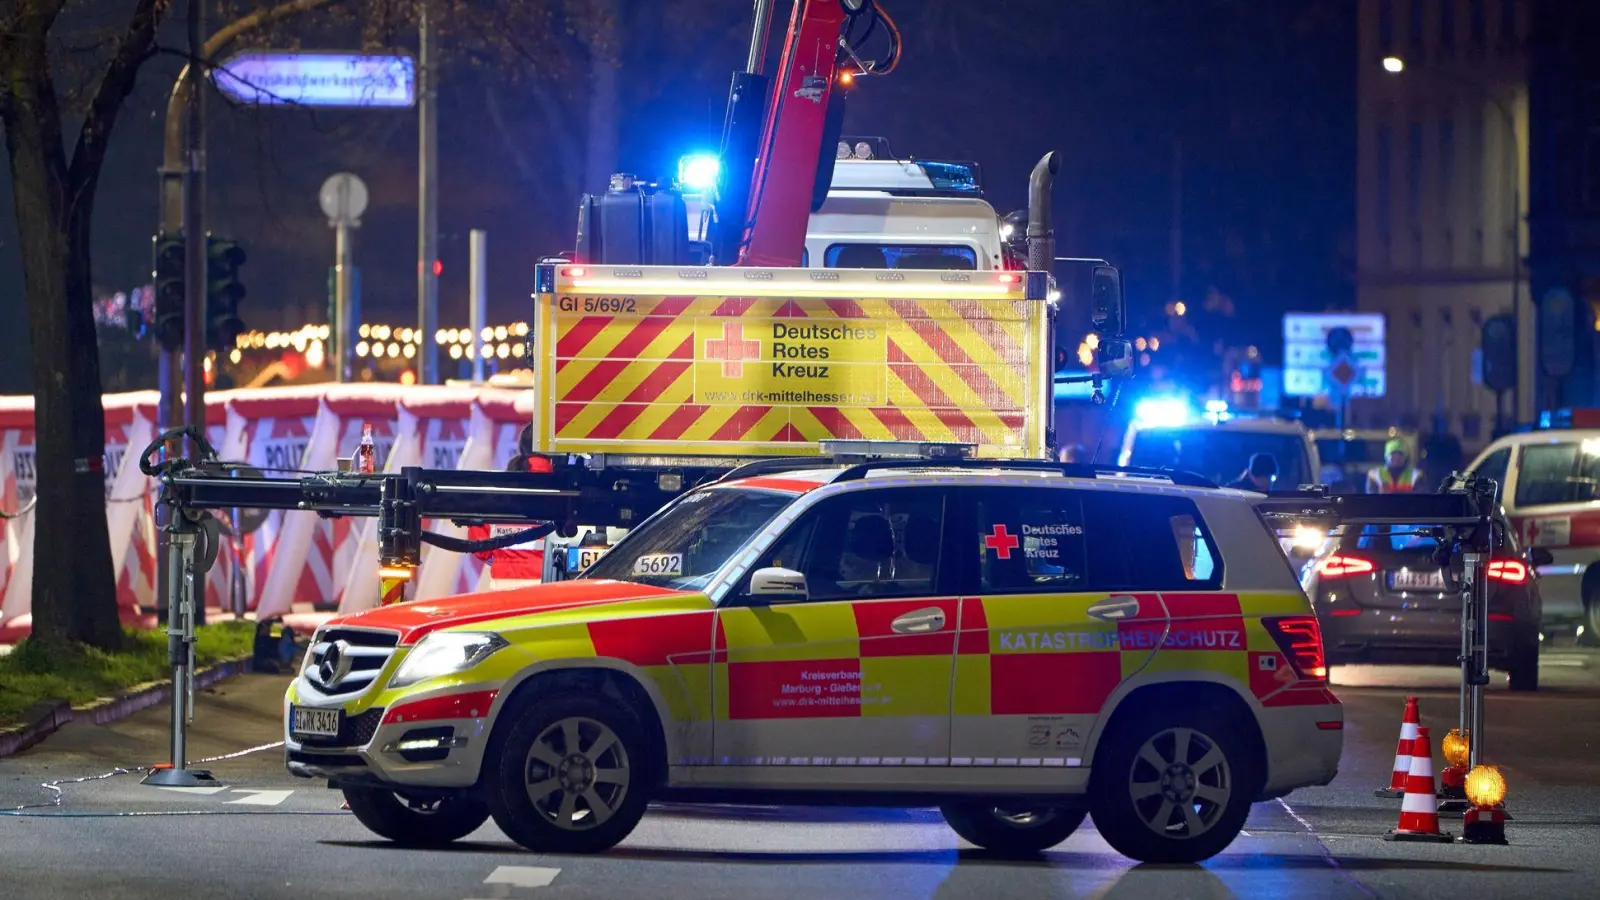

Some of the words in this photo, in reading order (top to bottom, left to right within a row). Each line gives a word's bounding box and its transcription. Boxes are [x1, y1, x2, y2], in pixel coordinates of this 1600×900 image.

[559, 296, 578, 311] GI
[584, 296, 636, 312] 5/69/2
[773, 323, 877, 340] Deutsches
[772, 342, 829, 359] Rotes
[772, 362, 829, 378] Kreuz
[1022, 524, 1082, 535] Deutsches
[1024, 536, 1058, 546] tes
[640, 556, 680, 573] 5692
[1000, 630, 1240, 649] KATASTROPHENSCHUTZ
[781, 684, 821, 695] Marburg
[317, 711, 337, 732] 3416
